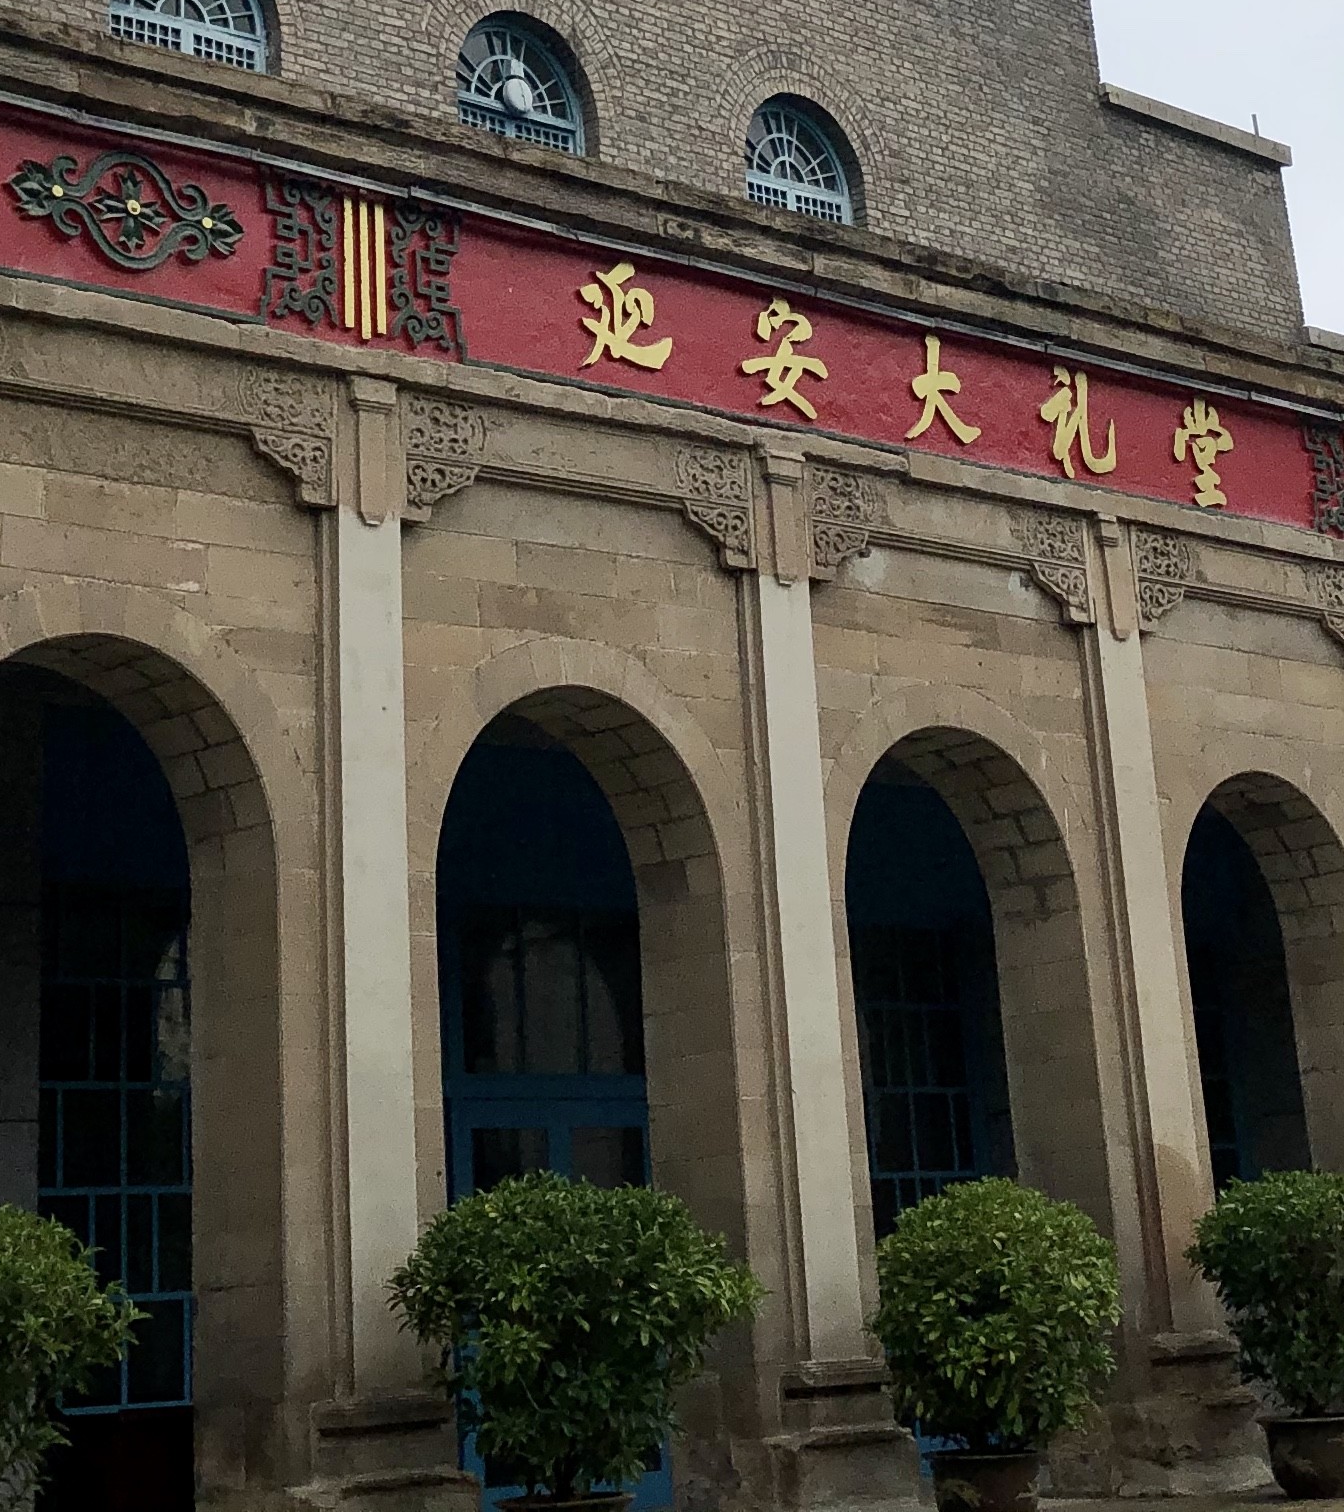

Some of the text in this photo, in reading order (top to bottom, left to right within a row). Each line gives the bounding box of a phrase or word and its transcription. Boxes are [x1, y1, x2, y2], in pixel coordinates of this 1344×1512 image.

[579, 262, 1234, 507] 延安大礼堂
